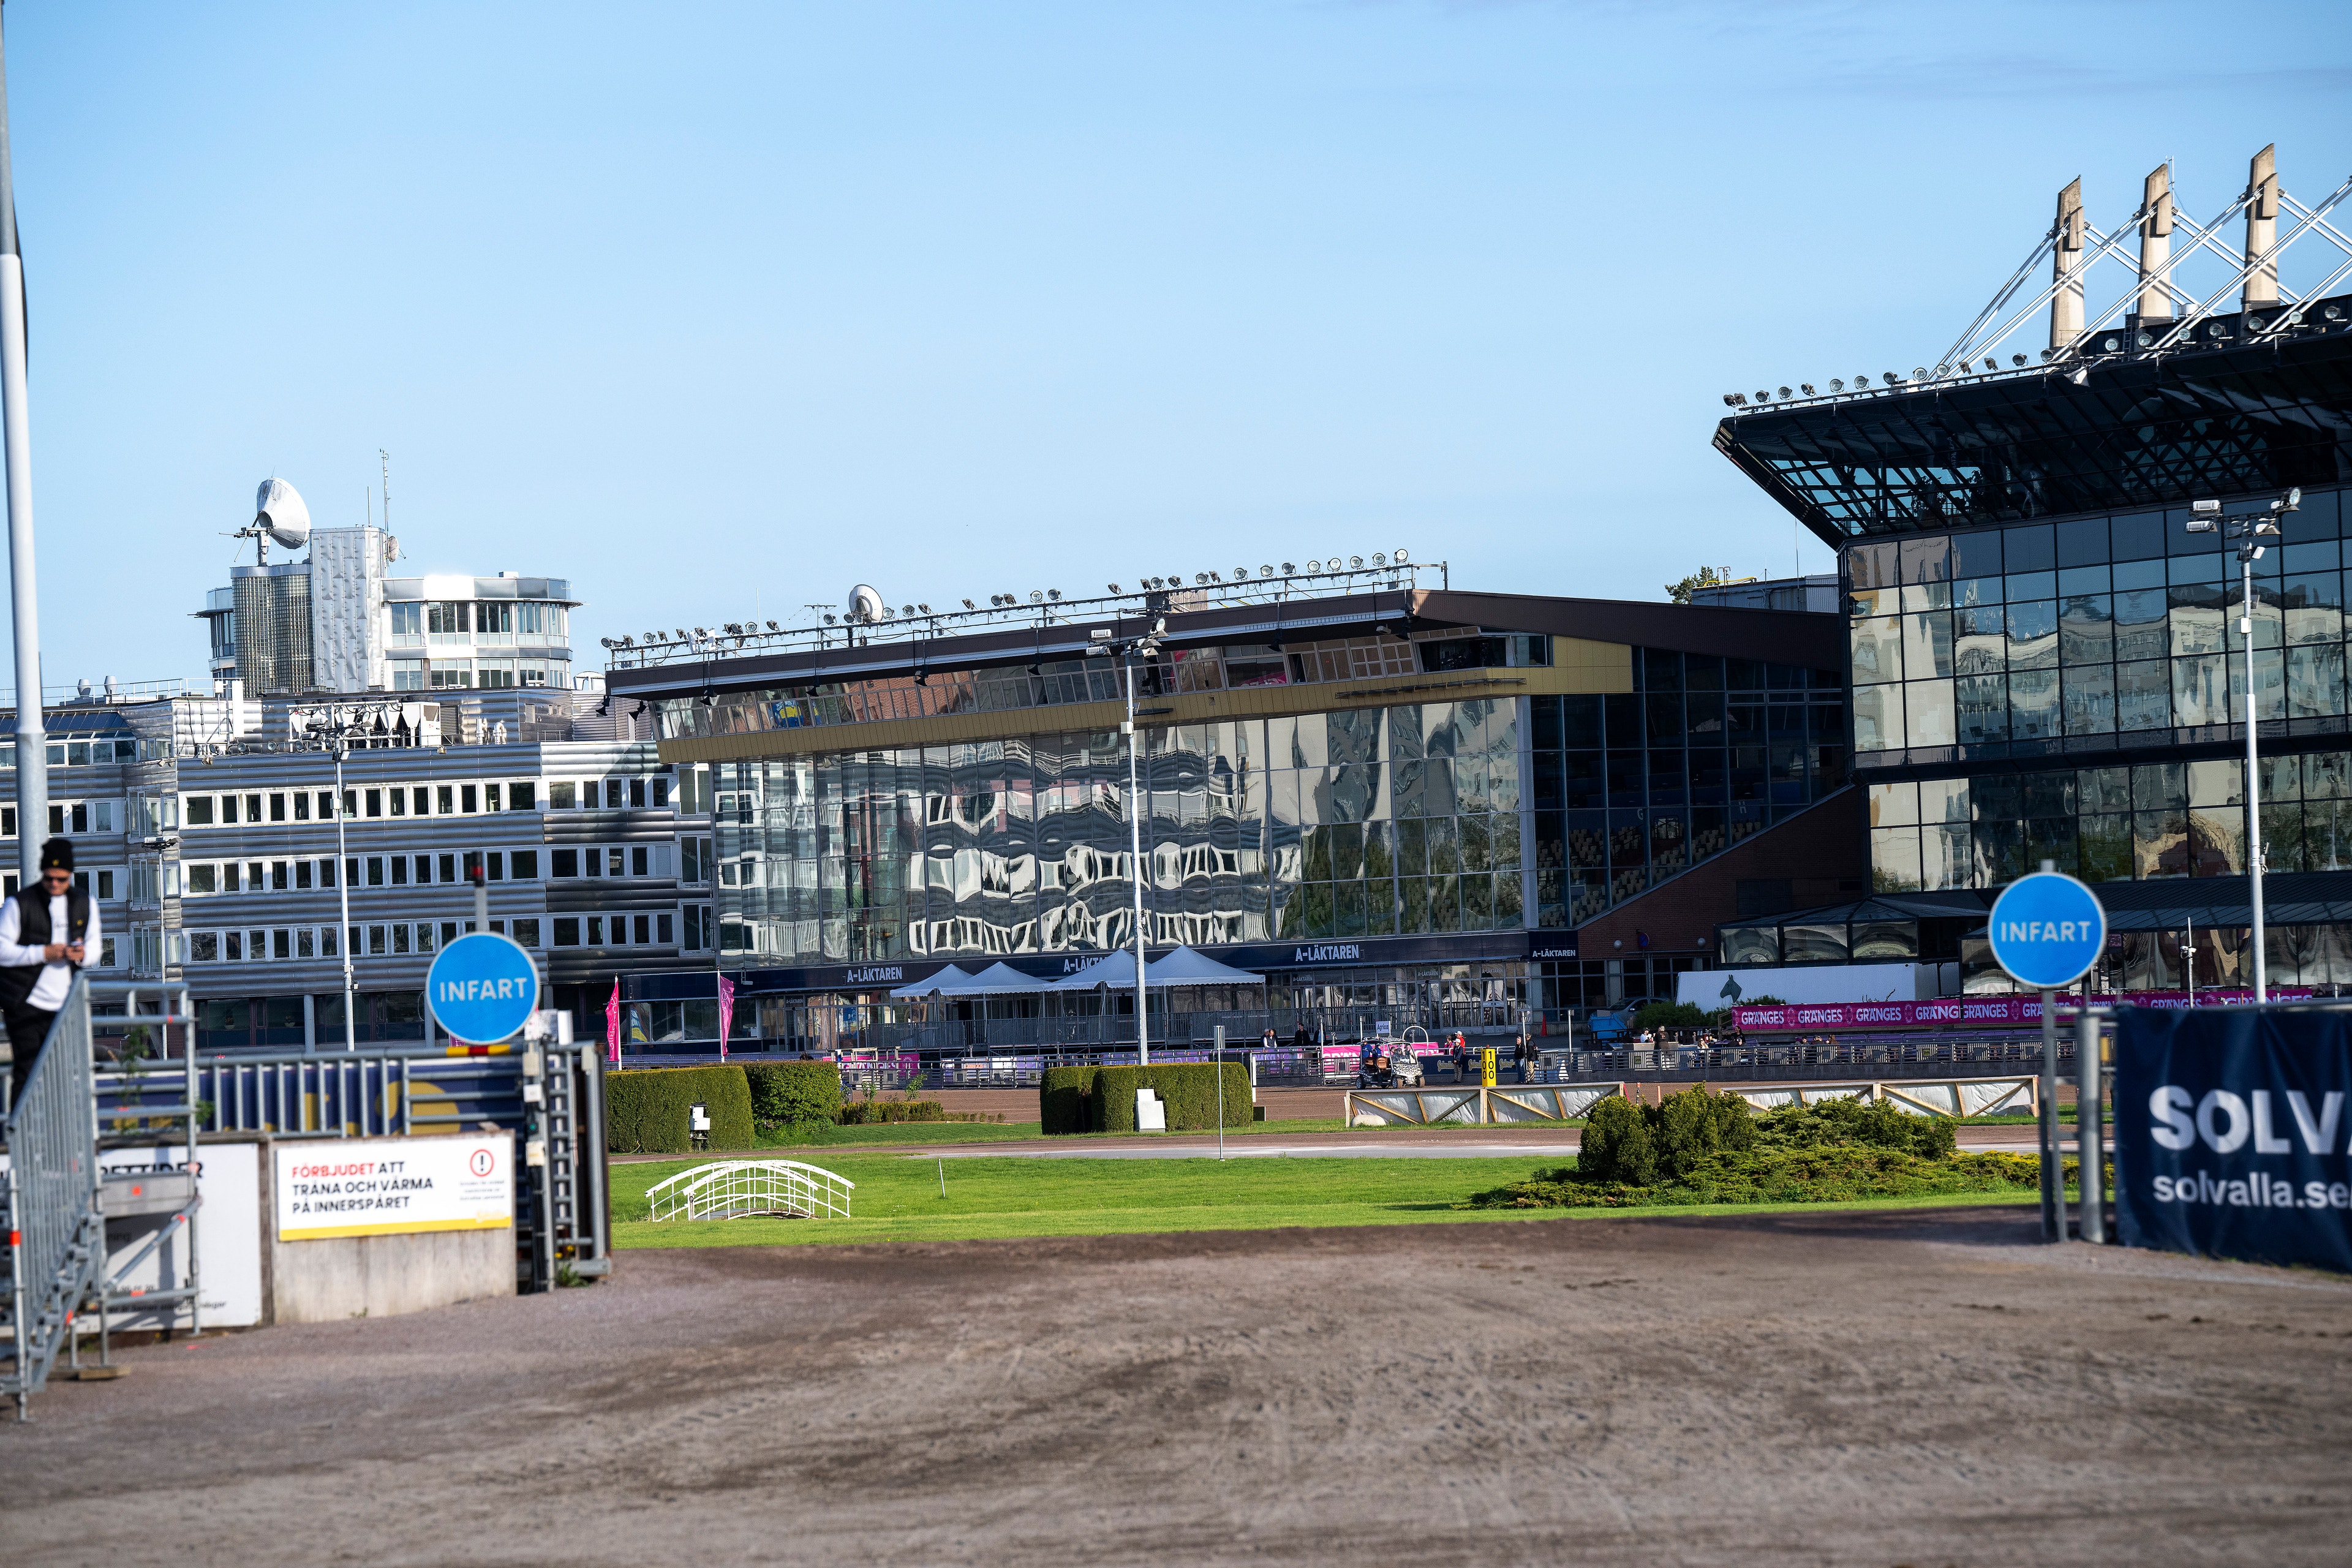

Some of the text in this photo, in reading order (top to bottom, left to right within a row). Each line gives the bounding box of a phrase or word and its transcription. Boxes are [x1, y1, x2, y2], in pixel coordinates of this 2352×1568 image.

[2001, 921, 2091, 942] INFART
[1295, 944, 1359, 961] A-LÄKTAREN
[1532, 949, 1576, 957] A-LÄKTAREN
[1063, 956, 1108, 972] A-LÄKT
[847, 967, 902, 982] A-LÄKTAREN
[440, 977, 527, 1003] INFART
[1963, 1003, 2008, 1018] GRÄNGES
[2150, 998, 2203, 1009] GRÄNGS
[1741, 1011, 1784, 1025] GRÄNGES
[1798, 1009, 1843, 1023] GRÄNGES
[1856, 1007, 1901, 1022] GRÄNGES
[2149, 1085, 2352, 1156] SOLV
[292, 1161, 405, 1178] FÖRBJUDET ATT
[293, 1175, 434, 1196] TRÄNA OCH VÄRMA
[2152, 1169, 2352, 1210] solvalla.se
[293, 1196, 410, 1215] PÅ INNERSPÅRET
